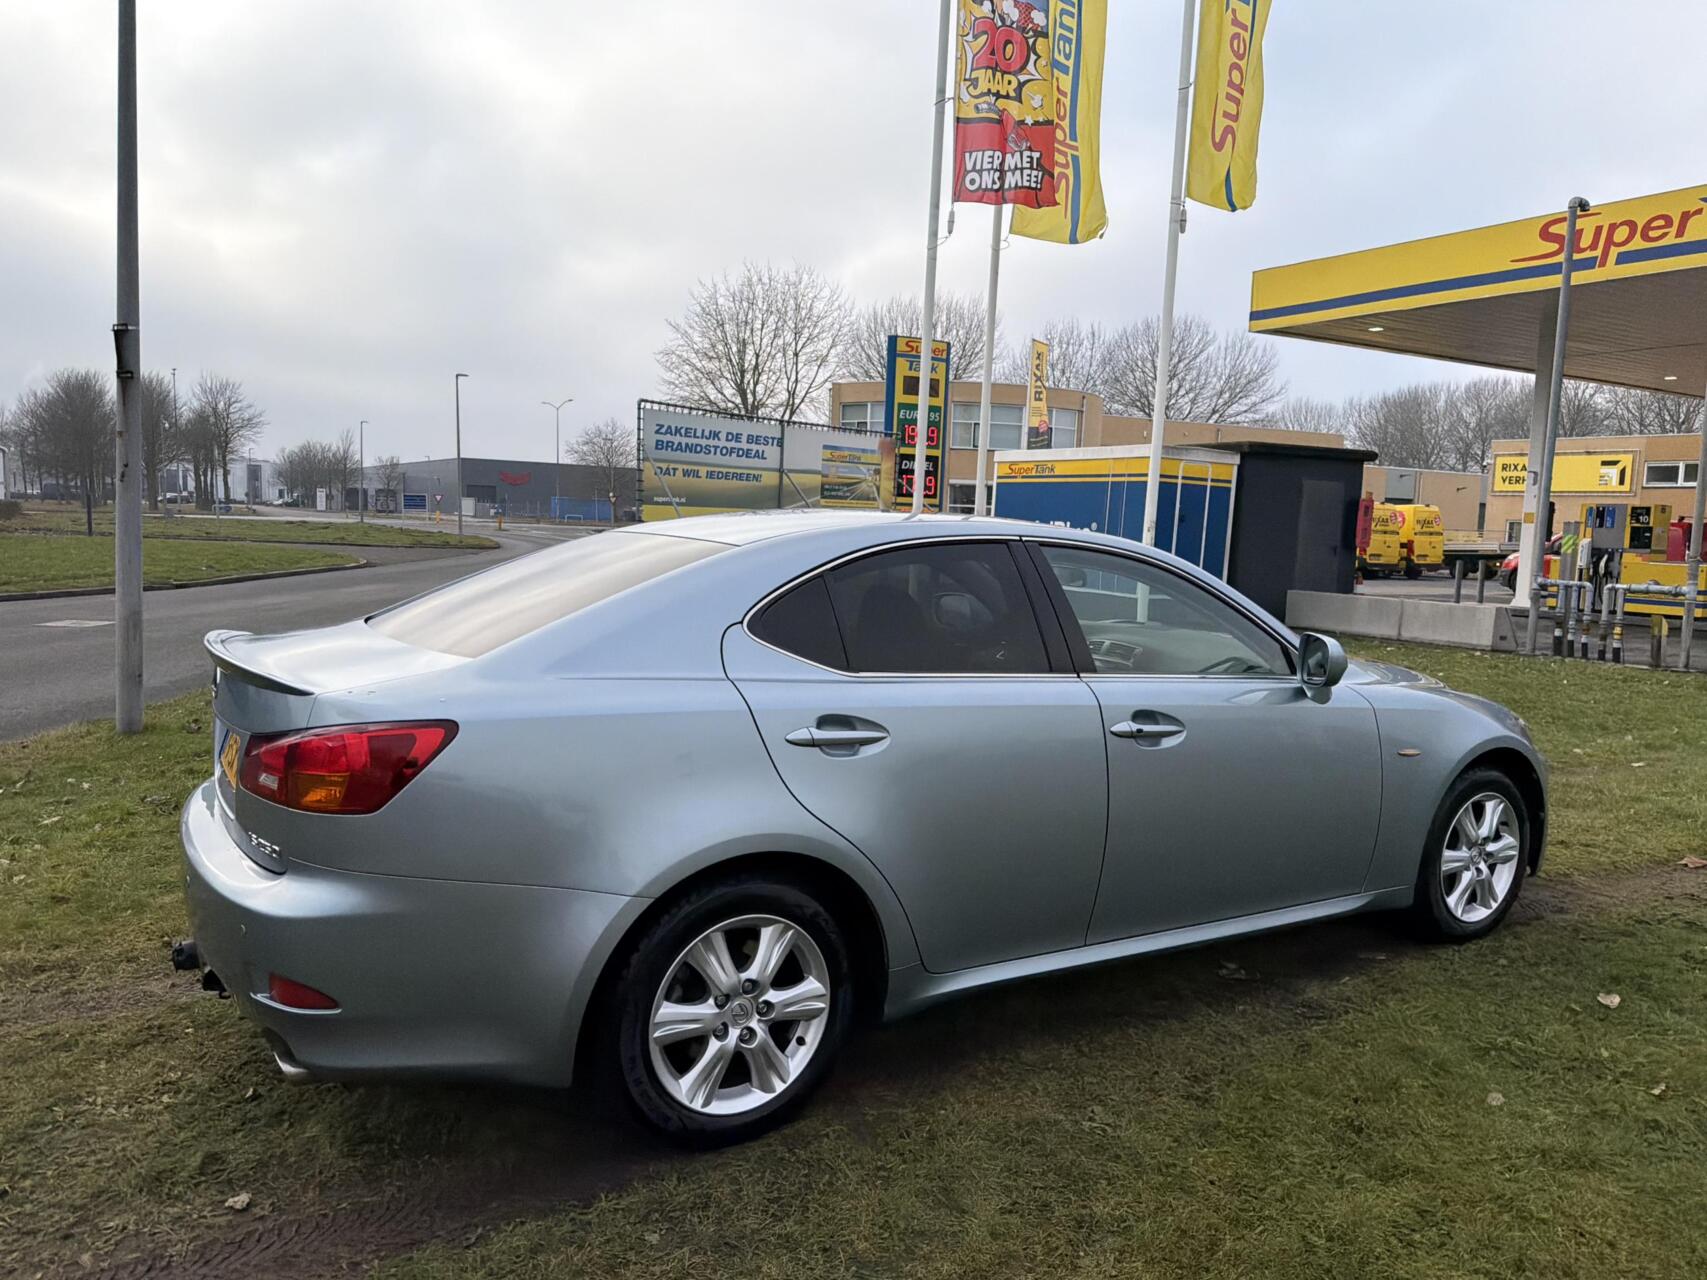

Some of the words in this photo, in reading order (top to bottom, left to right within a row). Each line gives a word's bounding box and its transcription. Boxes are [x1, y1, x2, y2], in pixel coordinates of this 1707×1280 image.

[972, 17, 1028, 72] 20
[968, 70, 1018, 97] JAAR
[1212, 0, 1250, 153] Super
[964, 150, 1002, 170] VIER
[1004, 151, 1041, 170] MET
[964, 171, 1001, 191] ONS
[1004, 171, 1043, 189] MEE!
[1509, 197, 1707, 268] Super
[899, 340, 946, 357] Suer
[904, 359, 939, 374] Tak
[899, 410, 922, 419] EUR
[929, 412, 940, 421] 95
[654, 424, 722, 441] ZAKELIJK
[725, 432, 743, 443] DE
[746, 435, 783, 447] BESTE
[904, 424, 938, 446] 19.9
[654, 440, 768, 460] BRANDSTOFDEAL
[654, 464, 679, 477] DÁT
[682, 468, 702, 479] WIL
[705, 470, 762, 483] IEDEREEN!
[1003, 464, 1056, 477] SuperTank
[1501, 463, 1528, 472] RIXA
[1639, 515, 1649, 523] 10
